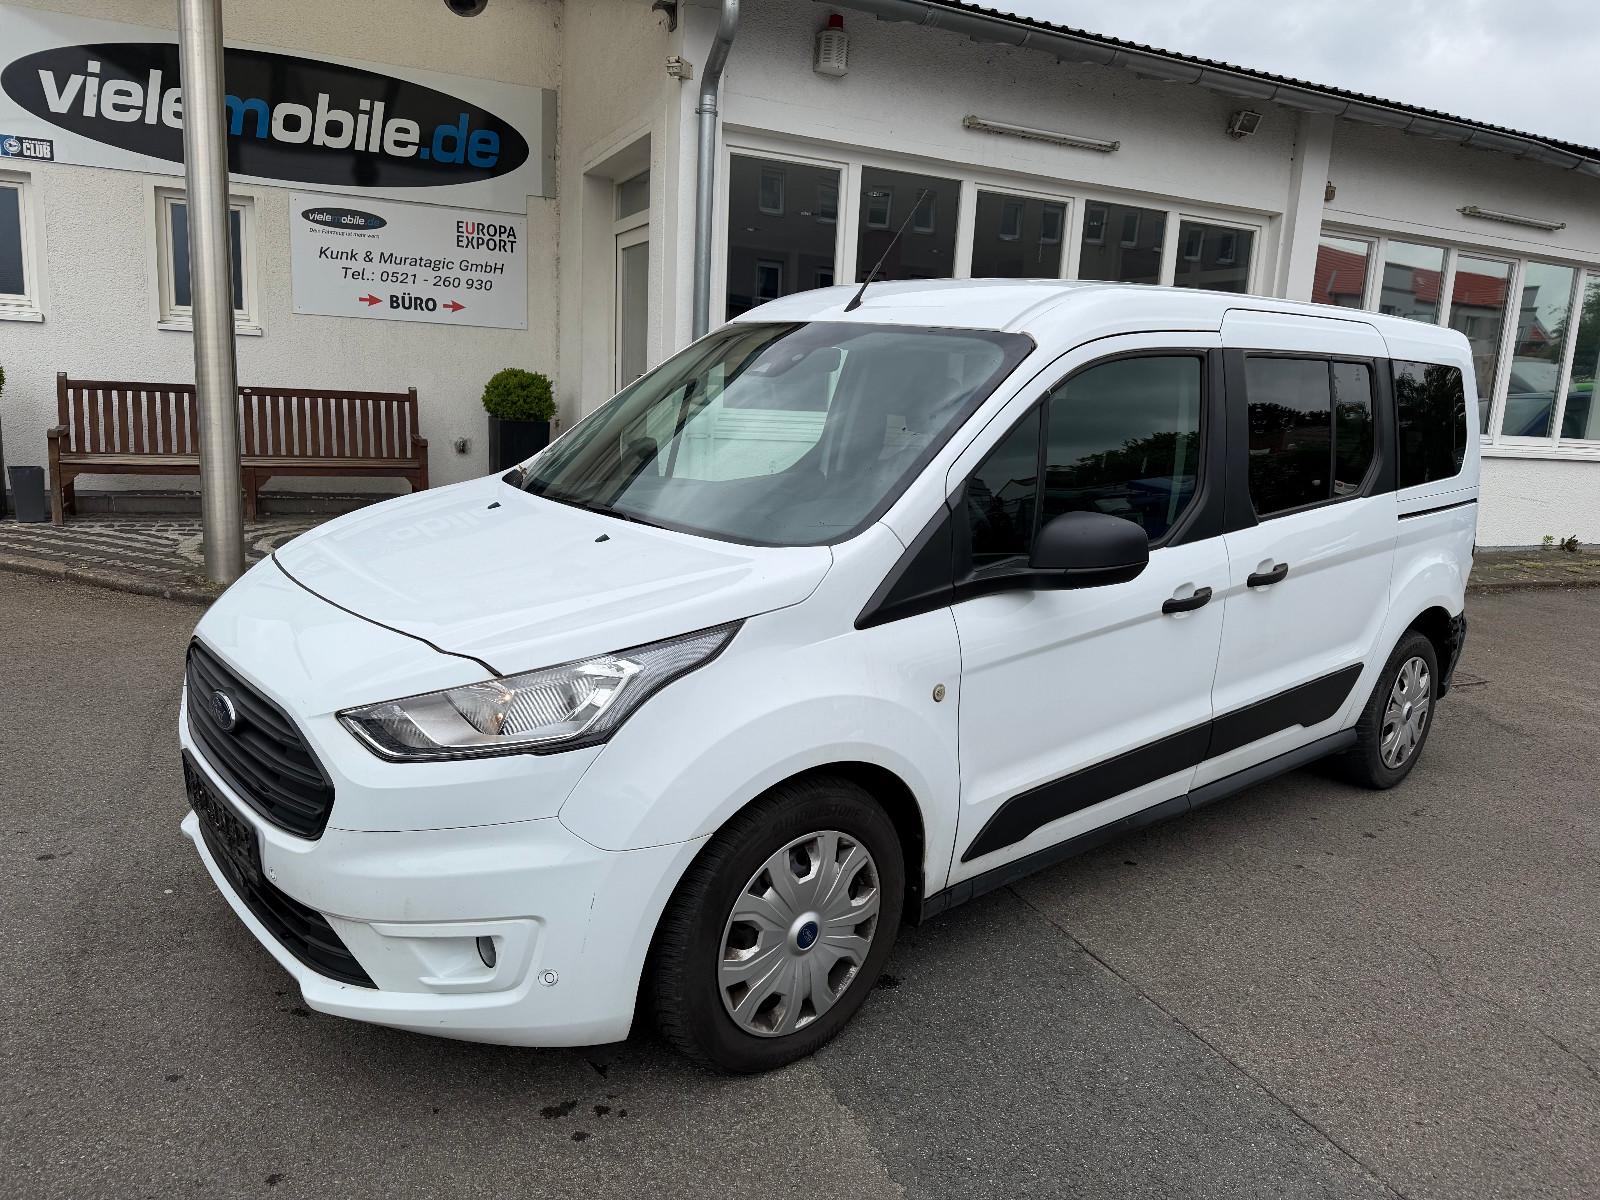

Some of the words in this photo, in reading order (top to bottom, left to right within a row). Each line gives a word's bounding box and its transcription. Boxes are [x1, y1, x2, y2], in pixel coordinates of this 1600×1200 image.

[22, 142, 51, 158] CLUB
[456, 220, 517, 240] EUROPA
[456, 235, 517, 254] EXPORT
[318, 246, 359, 262] Kunk
[363, 250, 374, 263] &
[379, 251, 455, 272] Muratagic
[459, 259, 505, 275] GmbH
[341, 266, 375, 281] Tel.:
[380, 270, 417, 285] 0521
[433, 275, 461, 288] 260
[465, 278, 493, 291] 930
[389, 292, 437, 312] BÜRO
